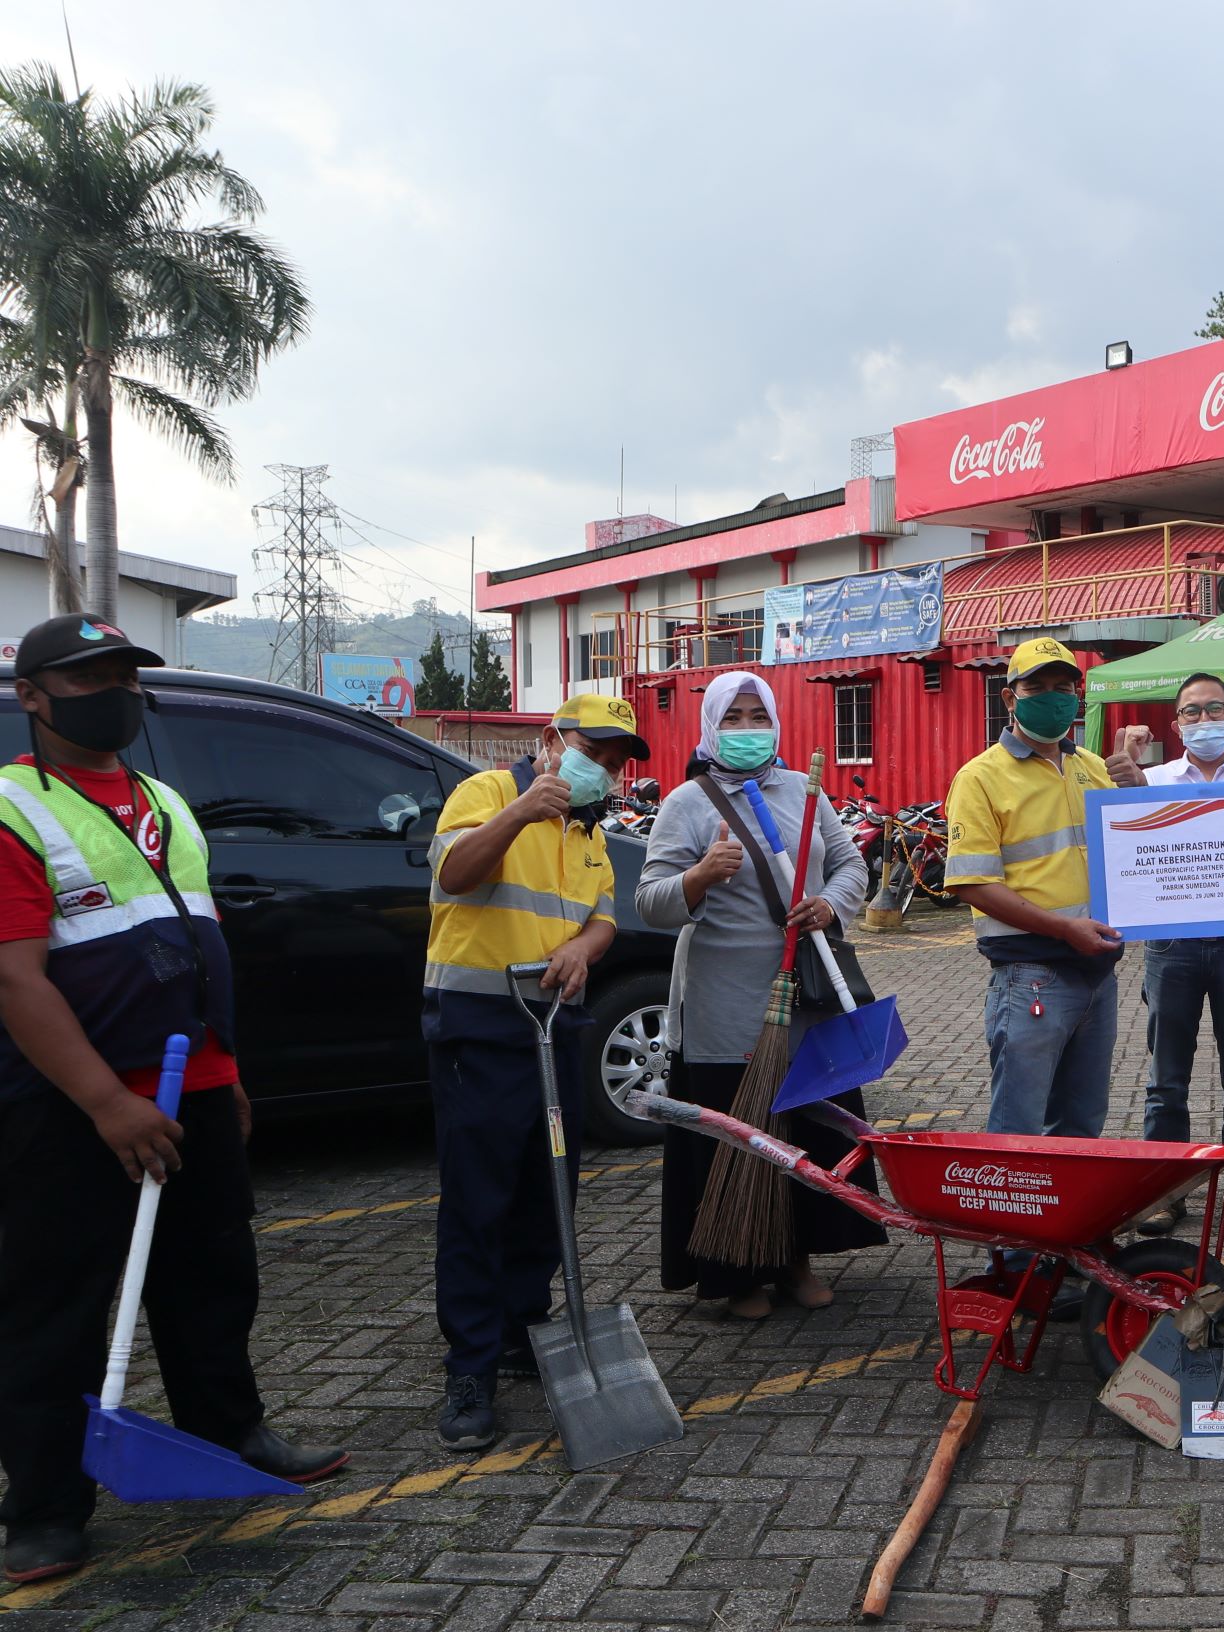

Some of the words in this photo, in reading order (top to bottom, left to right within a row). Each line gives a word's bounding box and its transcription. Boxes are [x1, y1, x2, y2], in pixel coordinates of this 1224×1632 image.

[949, 416, 1045, 485] Coca-Cola
[922, 599, 935, 610] LIVE
[922, 610, 937, 619] SAFE
[1035, 642, 1060, 652] CCA
[344, 679, 367, 690] CCA
[1090, 681, 1118, 691] frestea
[608, 702, 633, 722] CCA
[115, 804, 134, 816] JOY
[1136, 844, 1169, 854] DONASI
[1135, 857, 1156, 866] ALAT
[1158, 854, 1212, 865] KEBERSIHAN
[1120, 869, 1155, 877] COCA-COLA
[1156, 866, 1195, 875] EUROPACIFIC
[760, 1144, 790, 1166] ARTCO
[945, 1161, 1009, 1187] Coca-Cola
[1007, 1170, 1053, 1180] EUROPACIFIC
[1007, 1177, 1053, 1186] PARTNERS
[941, 1185, 976, 1197] BANTUAN
[978, 1189, 1009, 1200] SARANA
[1010, 1192, 1059, 1205] KEBERSIHAN
[960, 1196, 985, 1210] CCEP
[989, 1200, 1043, 1216] INDONESIA
[954, 1303, 999, 1321] ARTCO
